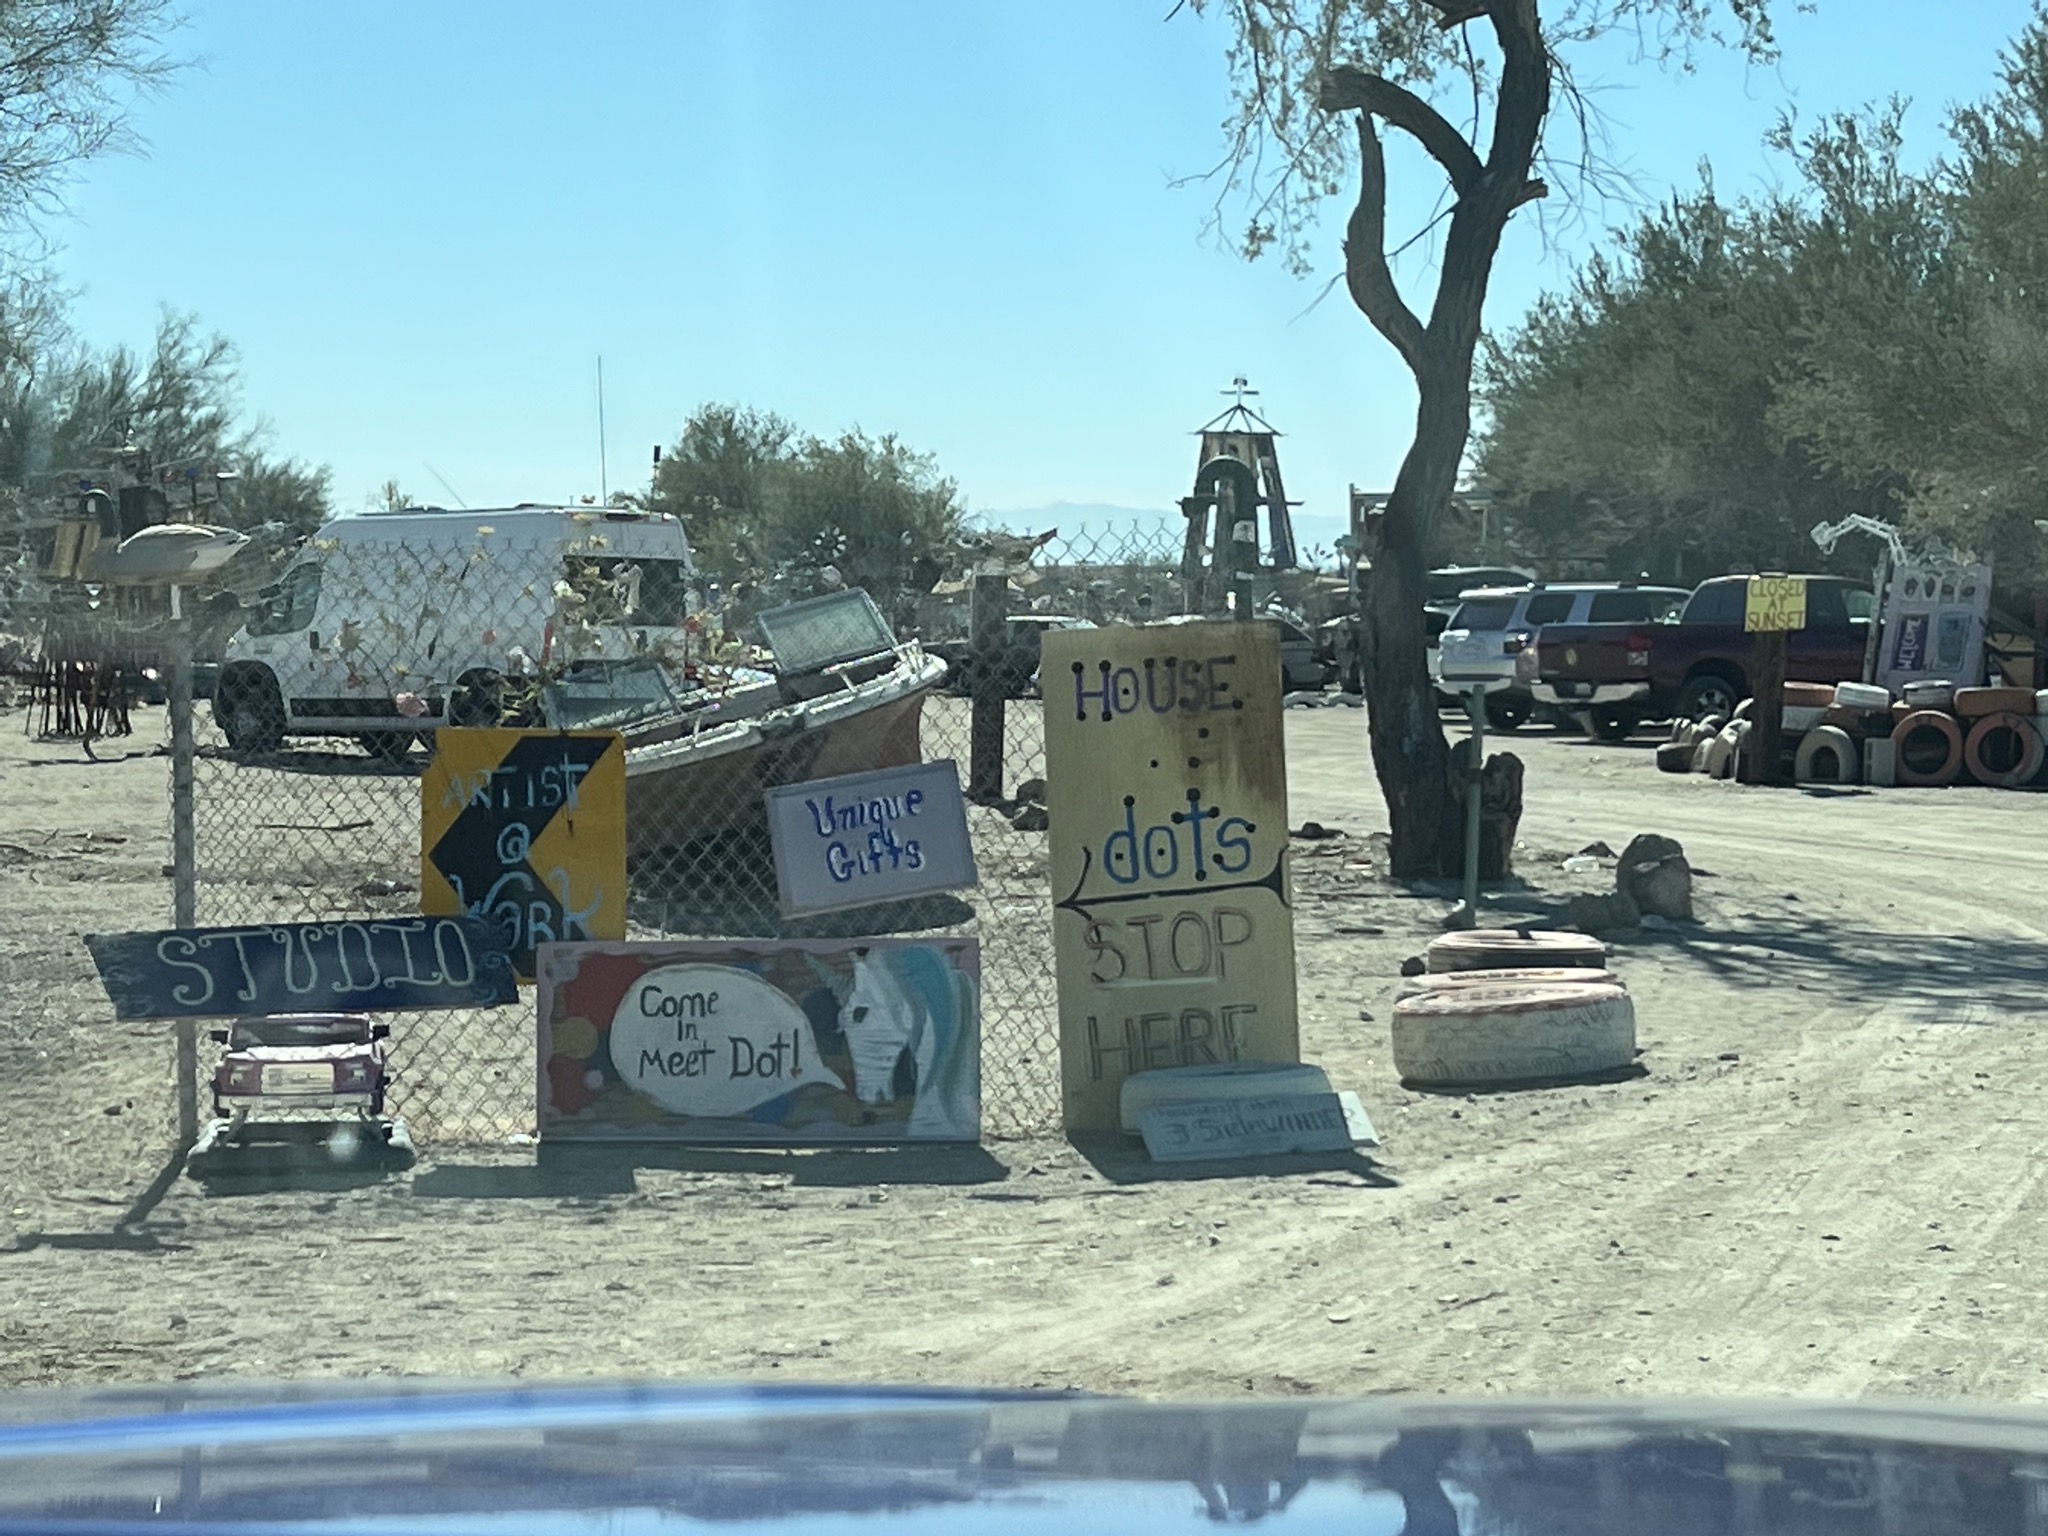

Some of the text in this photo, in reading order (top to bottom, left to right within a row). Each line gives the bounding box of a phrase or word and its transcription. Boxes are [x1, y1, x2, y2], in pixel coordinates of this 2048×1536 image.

[1751, 580, 1804, 598] CLOSED
[1767, 594, 1787, 612] AT
[1748, 611, 1804, 630] SUNSET
[1071, 654, 1243, 722] HOUSE
[442, 753, 588, 810] ARTIST
[497, 822, 529, 864] @
[805, 788, 923, 846] Unique
[1104, 788, 1256, 884] dots
[826, 830, 925, 883] Gifts
[157, 920, 475, 1005] STUDIO
[1083, 906, 1252, 983] STOP
[639, 985, 719, 1018] Come
[728, 1028, 802, 1081] Dot!
[1085, 1004, 1257, 1081] HERE
